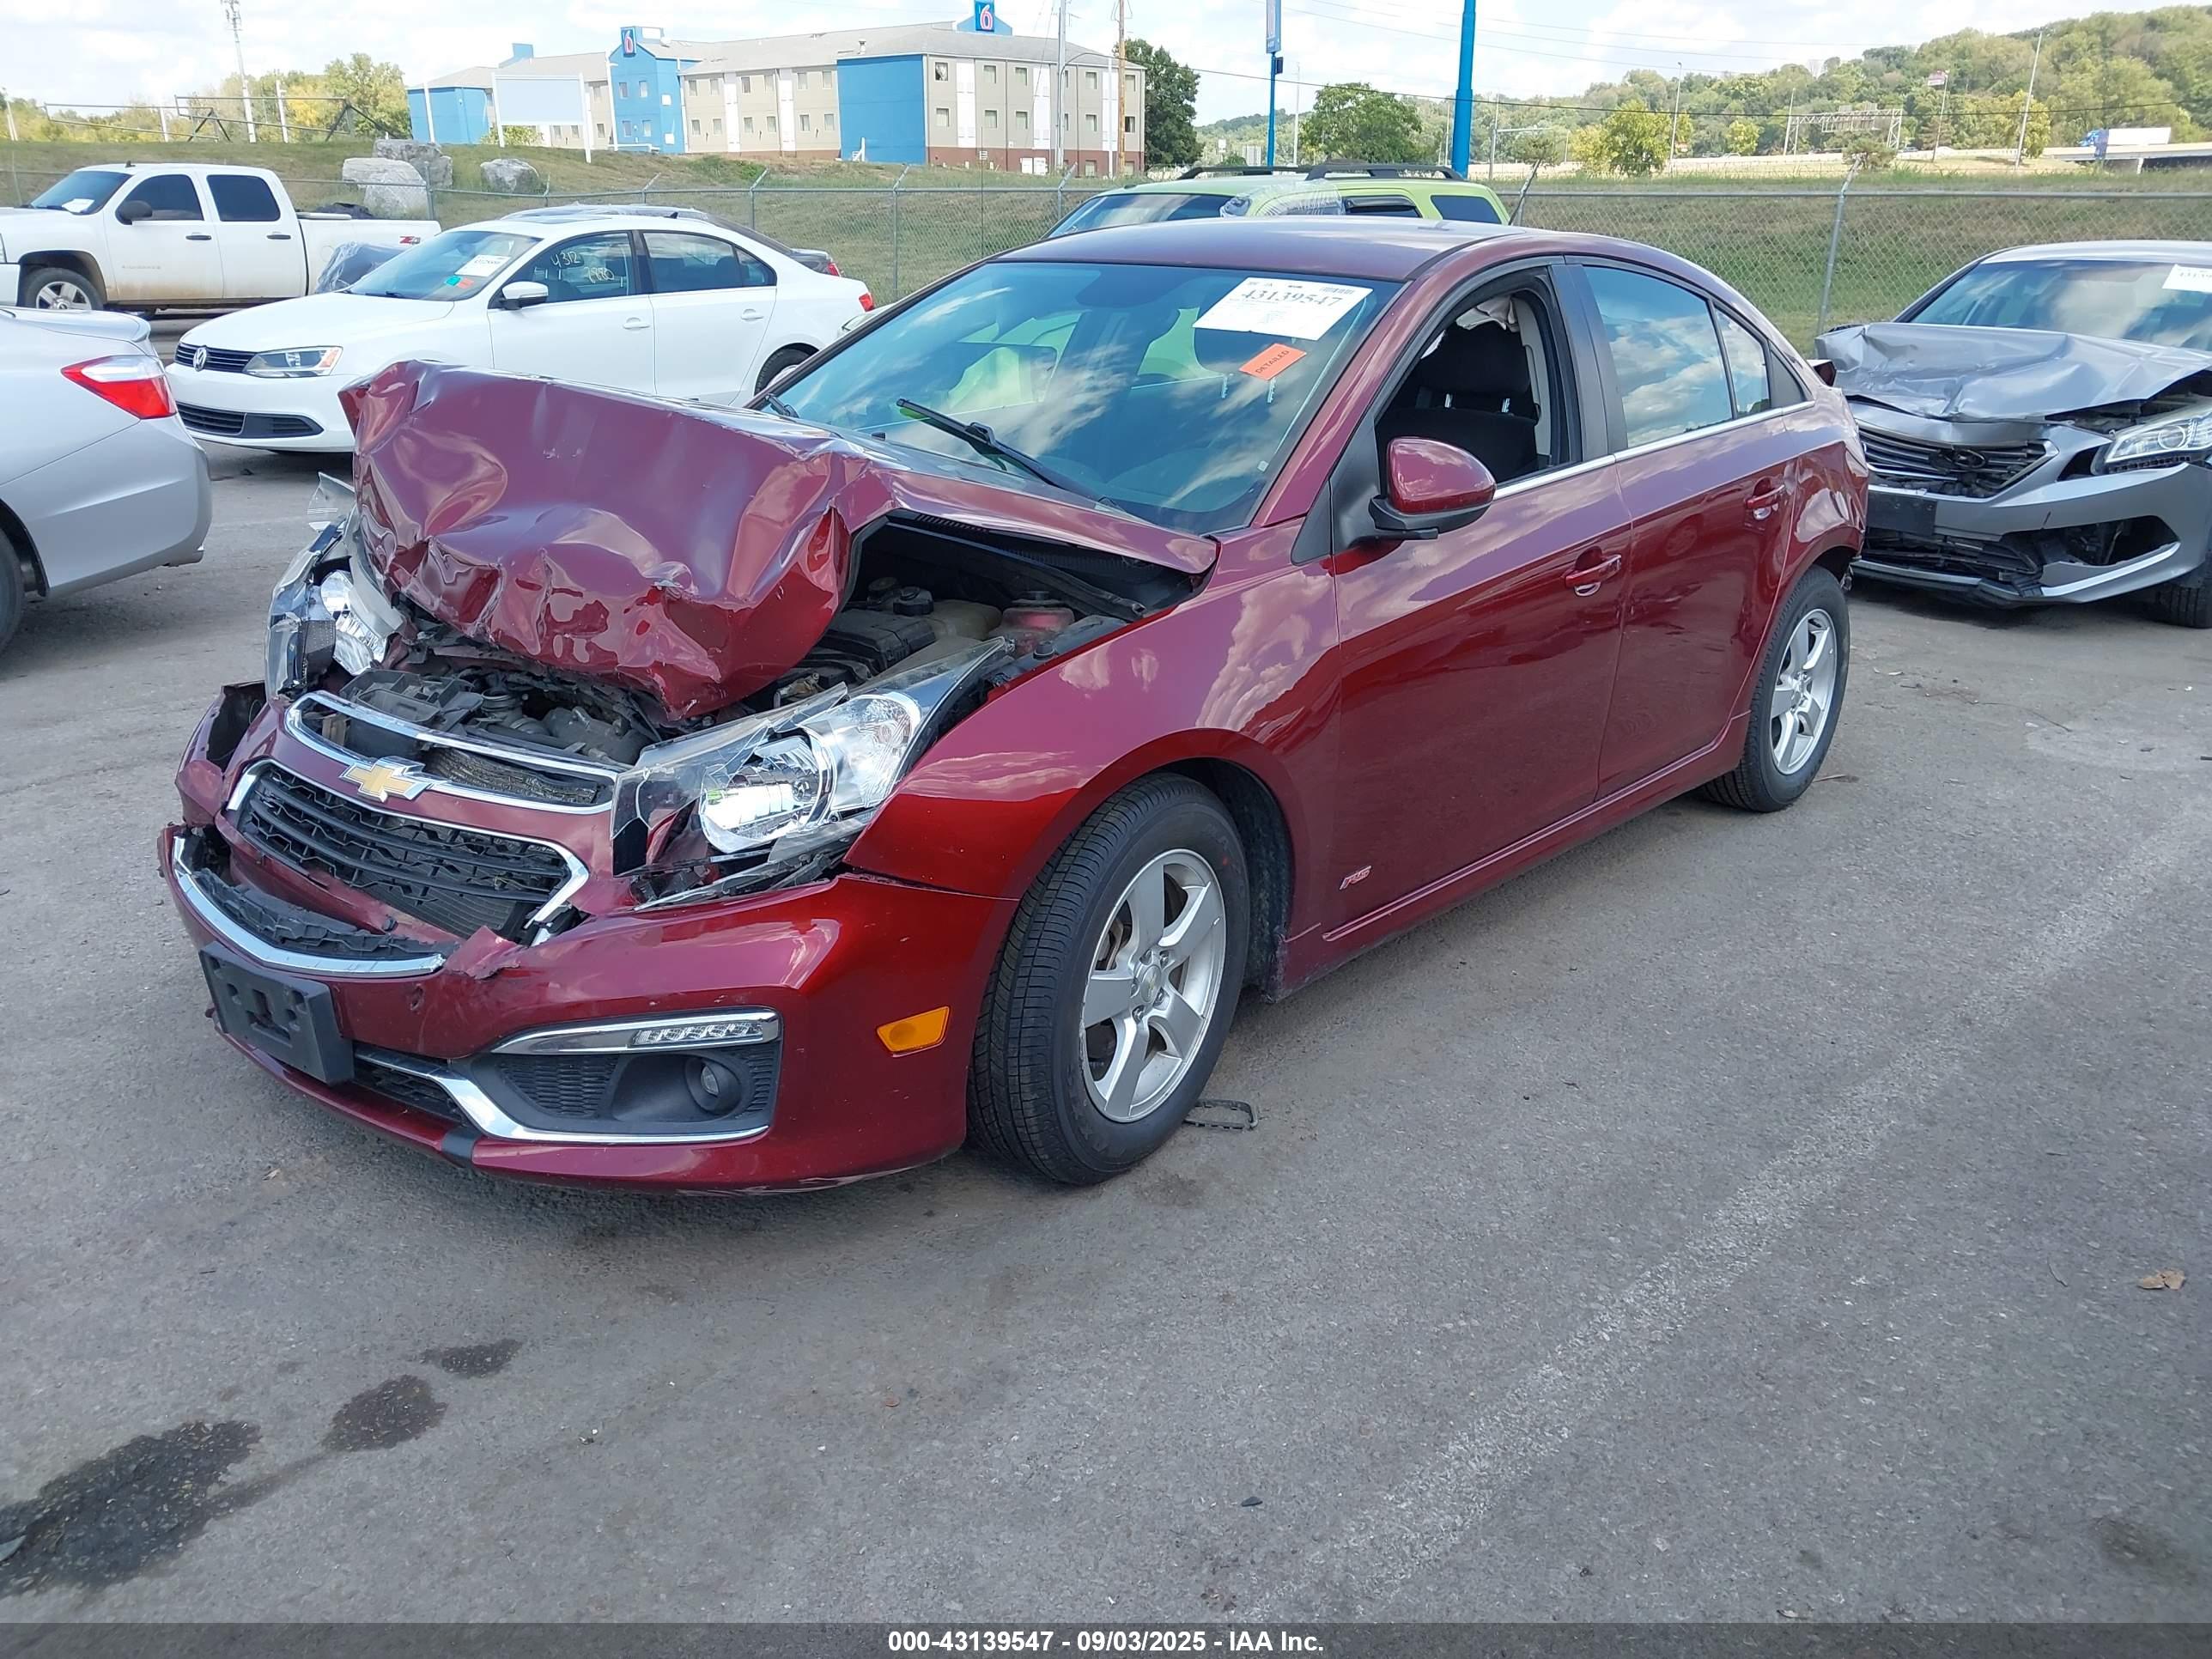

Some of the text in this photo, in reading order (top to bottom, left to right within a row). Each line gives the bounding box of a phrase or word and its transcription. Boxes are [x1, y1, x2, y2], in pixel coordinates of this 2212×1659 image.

[980, 4, 993, 30] 6
[1242, 289, 1343, 307] 43139547
[1255, 350, 1290, 374] DETAILED
